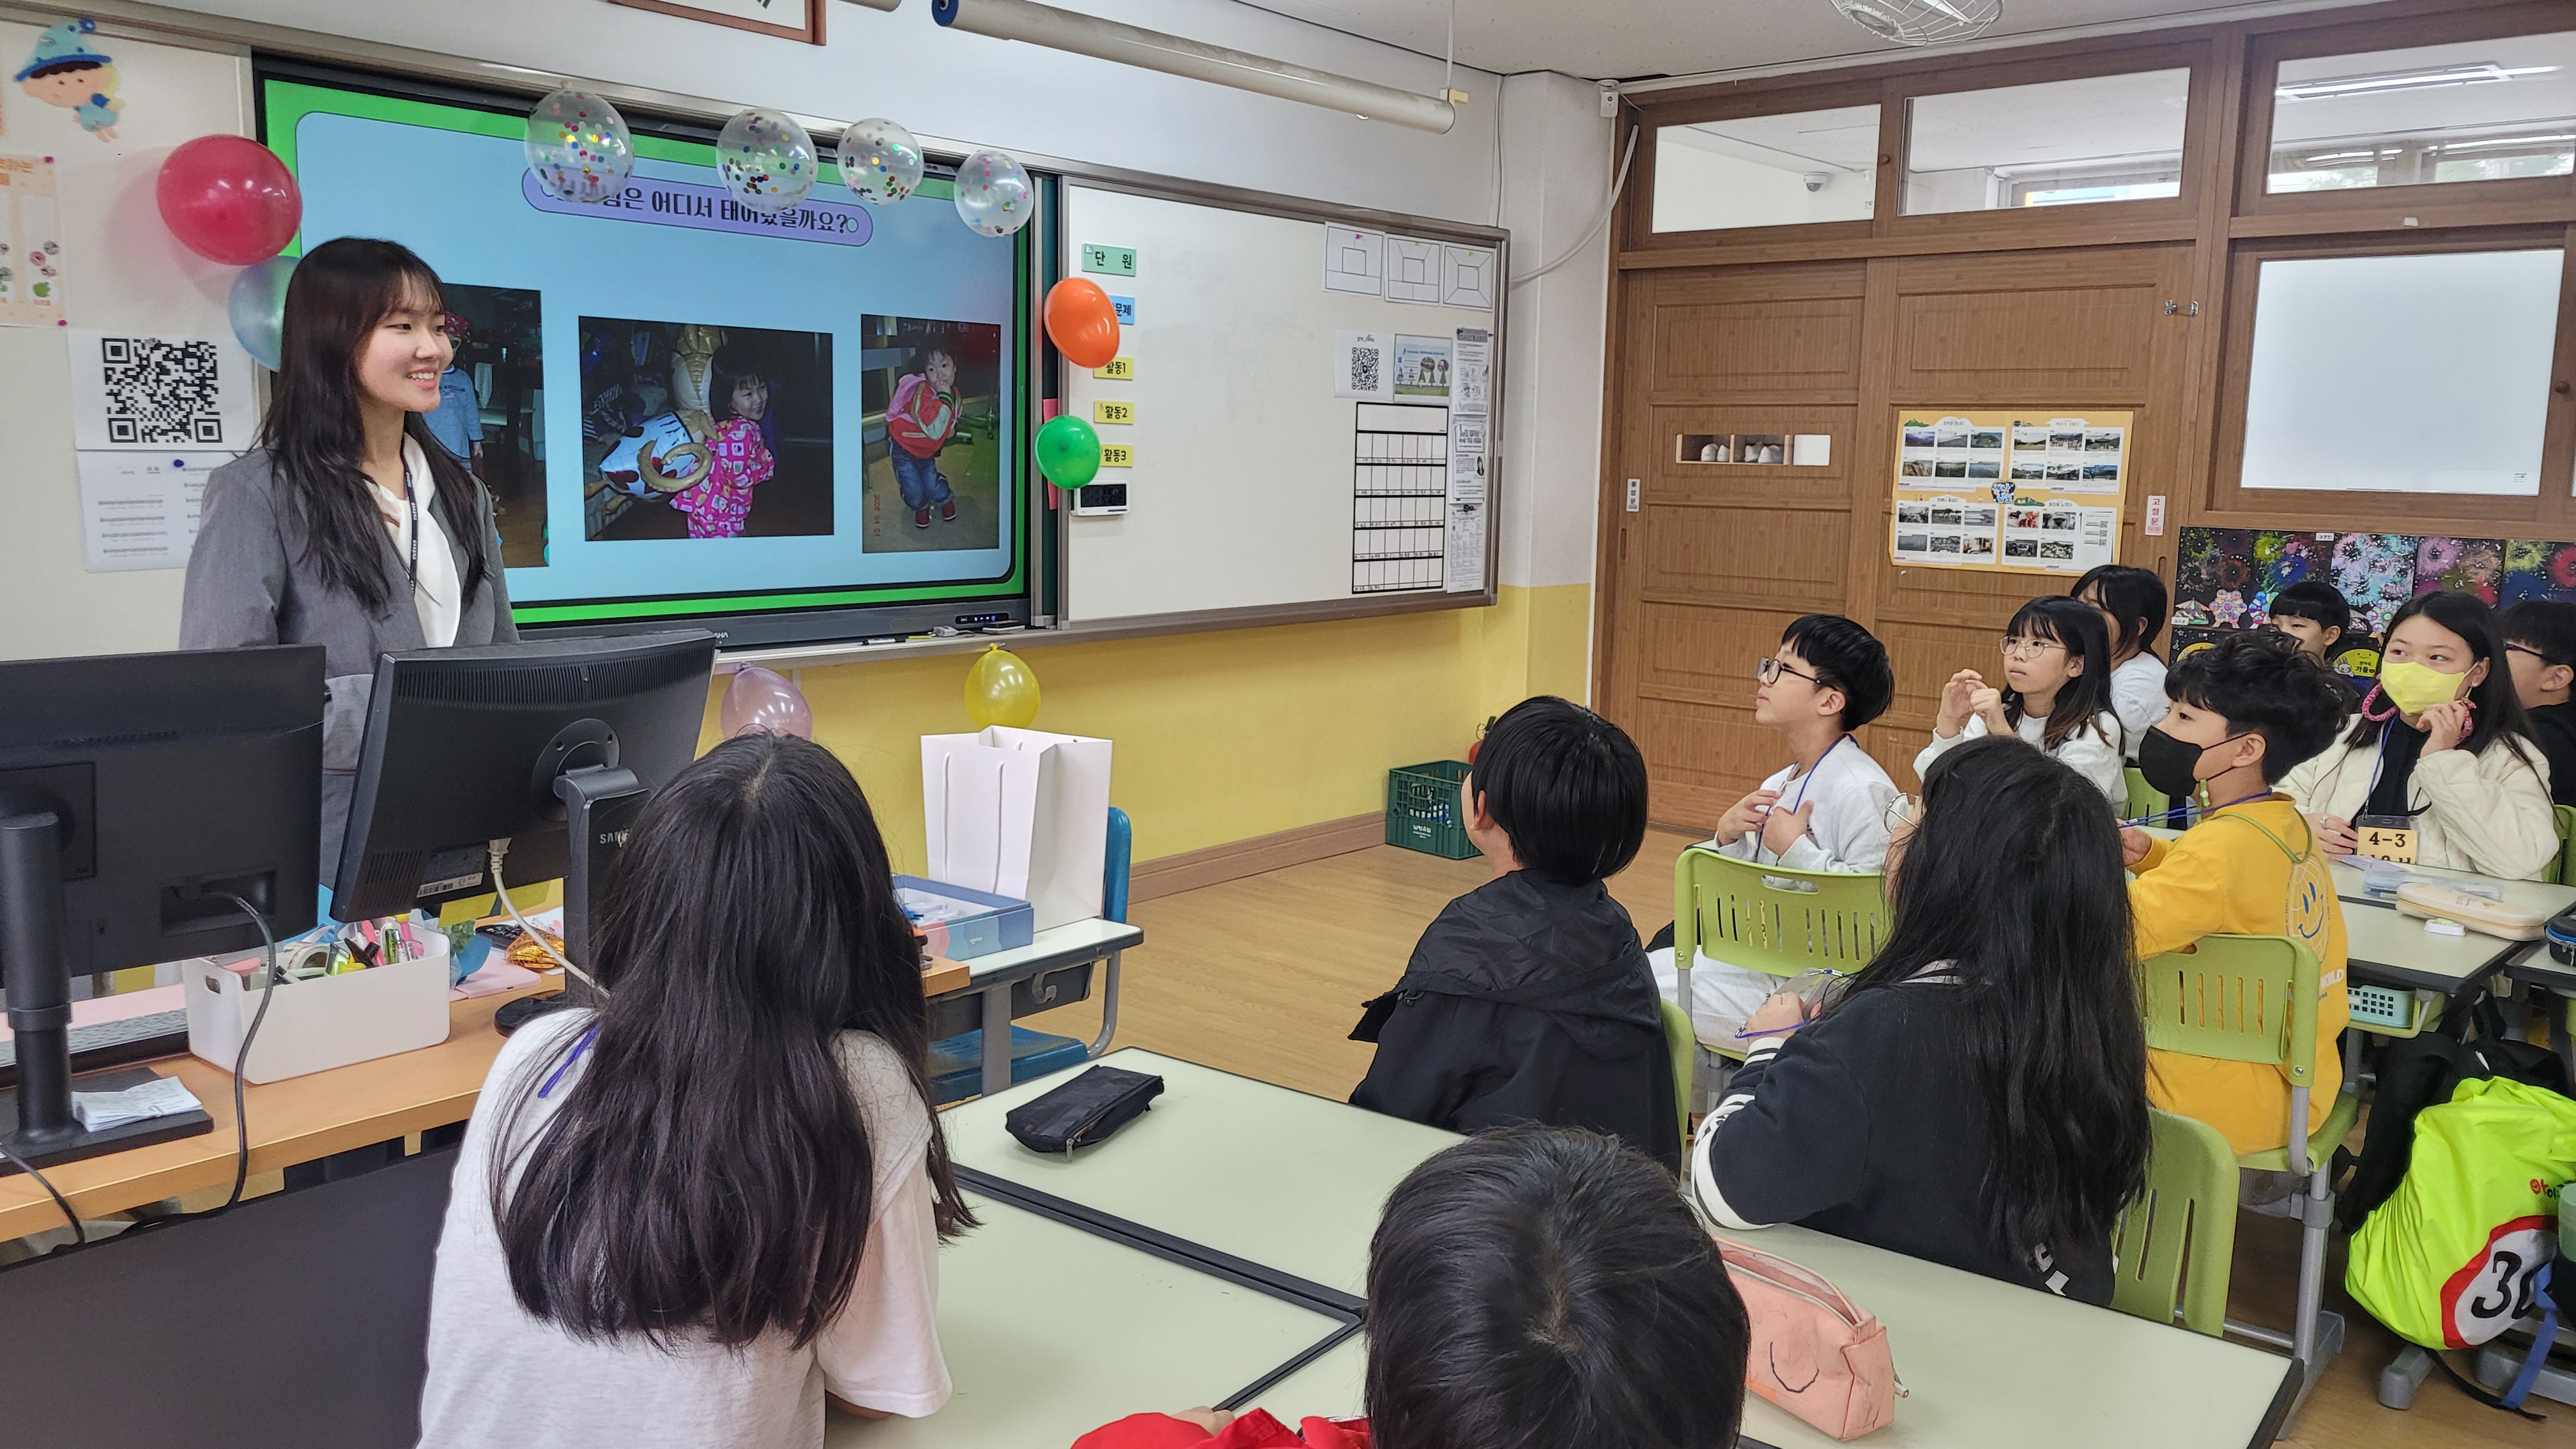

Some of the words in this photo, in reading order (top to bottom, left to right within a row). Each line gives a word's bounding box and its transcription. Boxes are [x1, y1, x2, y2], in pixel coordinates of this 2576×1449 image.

[652, 190, 713, 219] 어디서
[1112, 302, 1131, 317] 문제
[1106, 361, 1126, 375] 활동1
[1105, 404, 1128, 420] 활동2
[1104, 448, 1126, 463] 활동3
[2151, 498, 2161, 526] 고정문
[2368, 831, 2406, 848] 4-3
